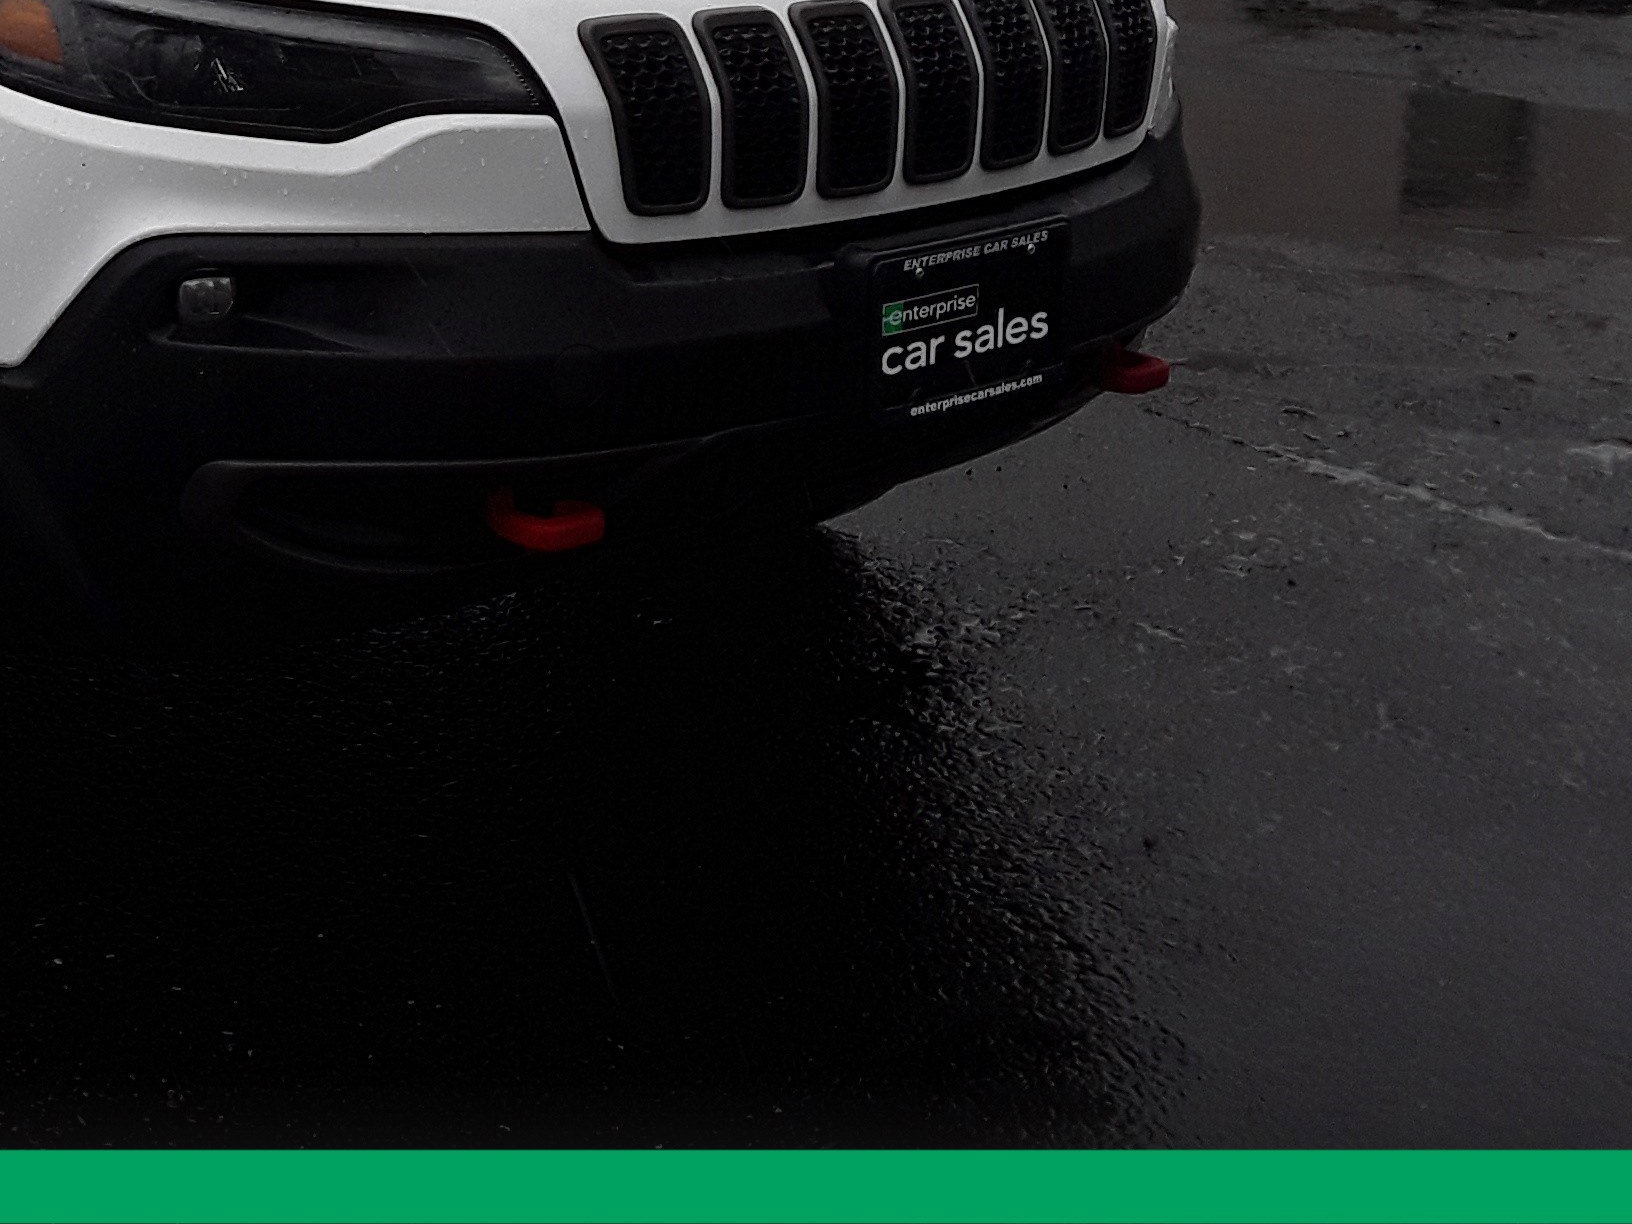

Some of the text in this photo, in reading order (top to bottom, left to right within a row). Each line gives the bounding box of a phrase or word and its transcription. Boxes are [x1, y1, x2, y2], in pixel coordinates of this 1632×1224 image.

[904, 230, 1048, 271] ENTERPRISE CAR SALES
[889, 295, 977, 322] enterprise
[881, 307, 1049, 376] car sales
[910, 374, 1043, 417] enterprisecarsales.com
